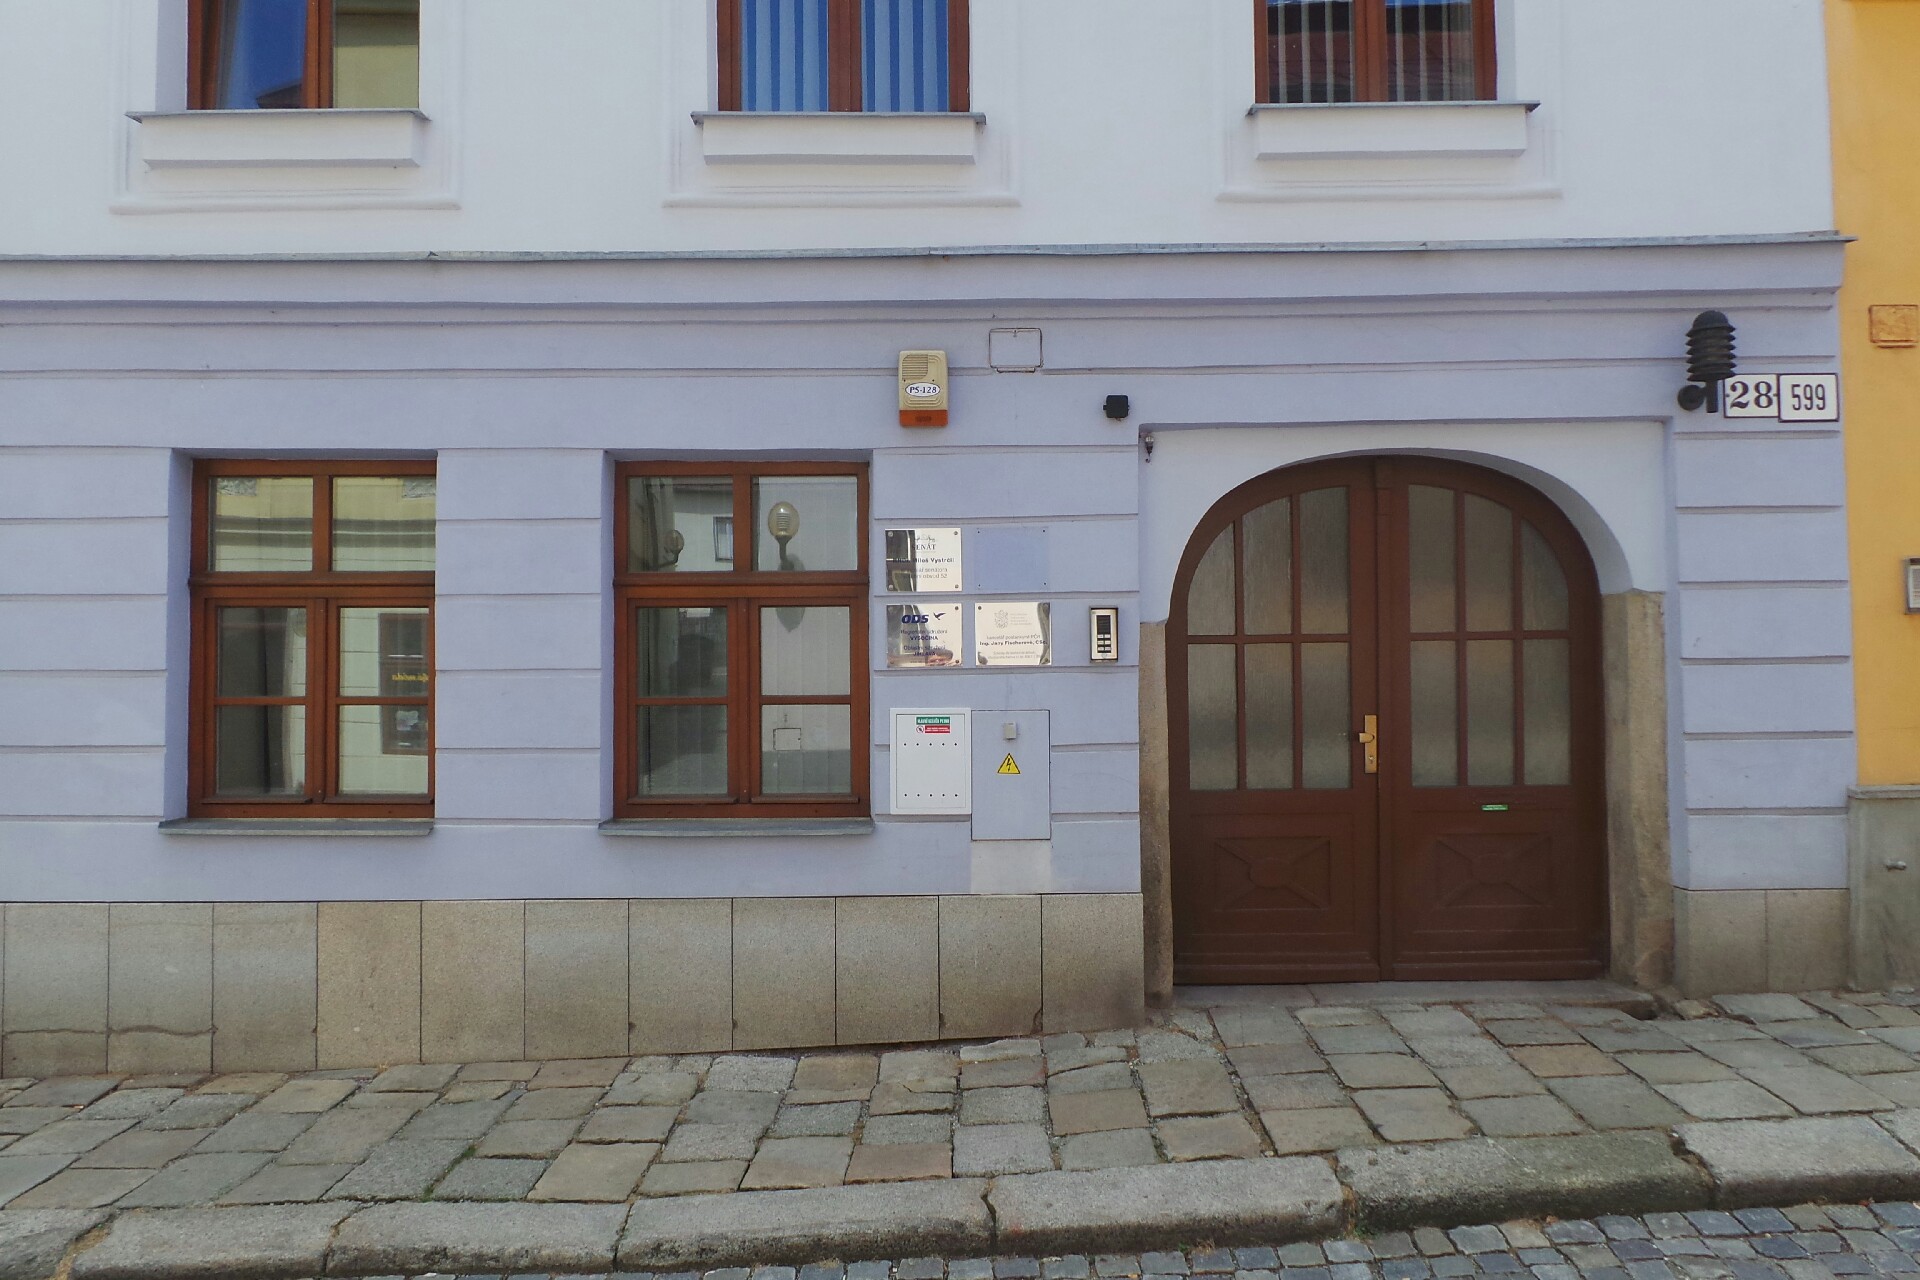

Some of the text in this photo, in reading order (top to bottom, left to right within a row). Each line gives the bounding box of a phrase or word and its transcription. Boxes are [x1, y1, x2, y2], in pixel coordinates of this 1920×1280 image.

[1729, 380, 1773, 409] 28
[1791, 383, 1826, 411] 599
[901, 614, 929, 624] ODS
